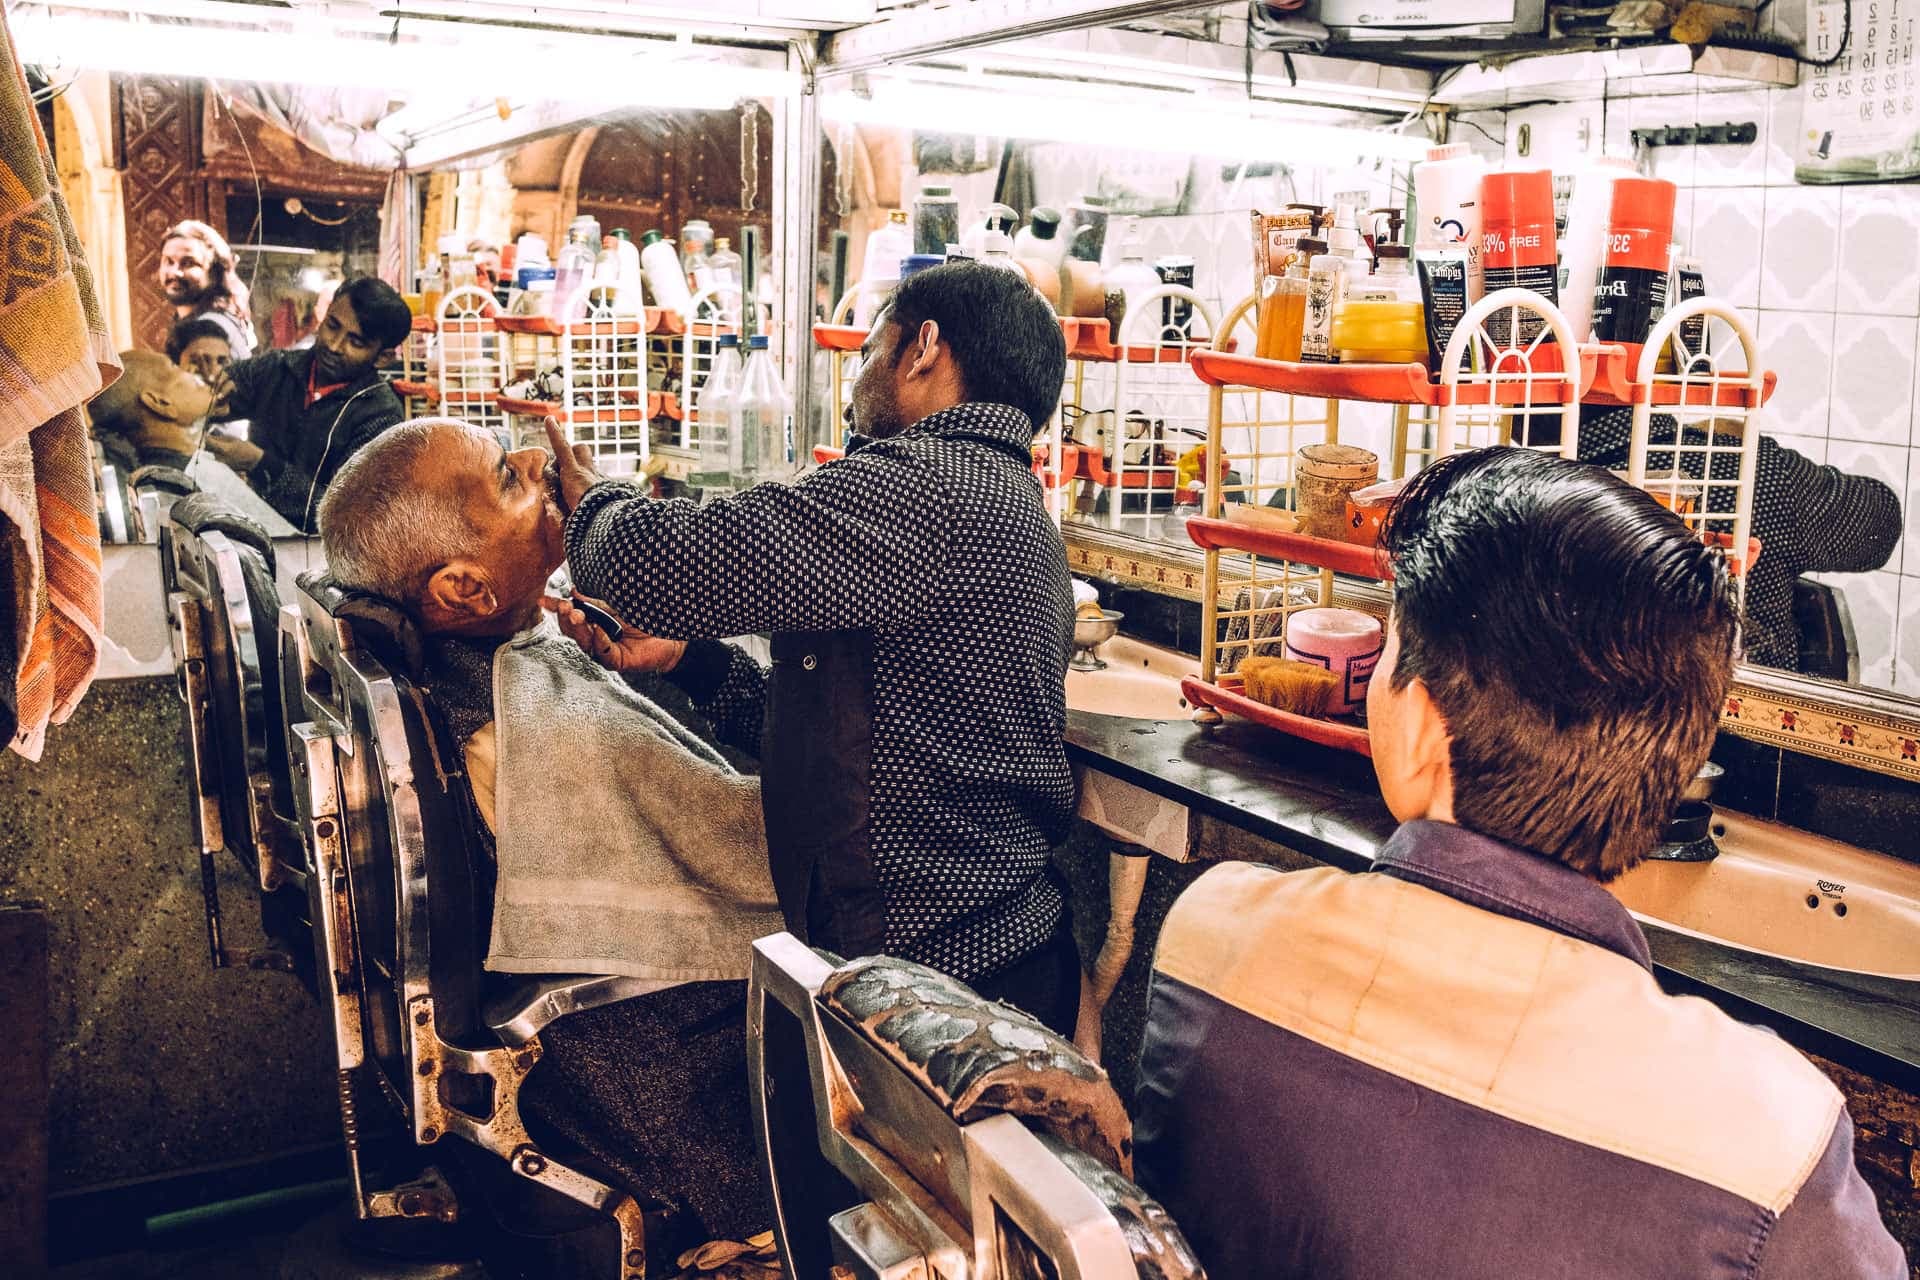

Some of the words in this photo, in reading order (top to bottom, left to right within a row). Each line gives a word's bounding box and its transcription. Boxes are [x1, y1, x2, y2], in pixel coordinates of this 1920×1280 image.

[1509, 235, 1541, 248] FREE
[1428, 264, 1462, 281] Campus
[1816, 880, 1846, 893] ROMER
